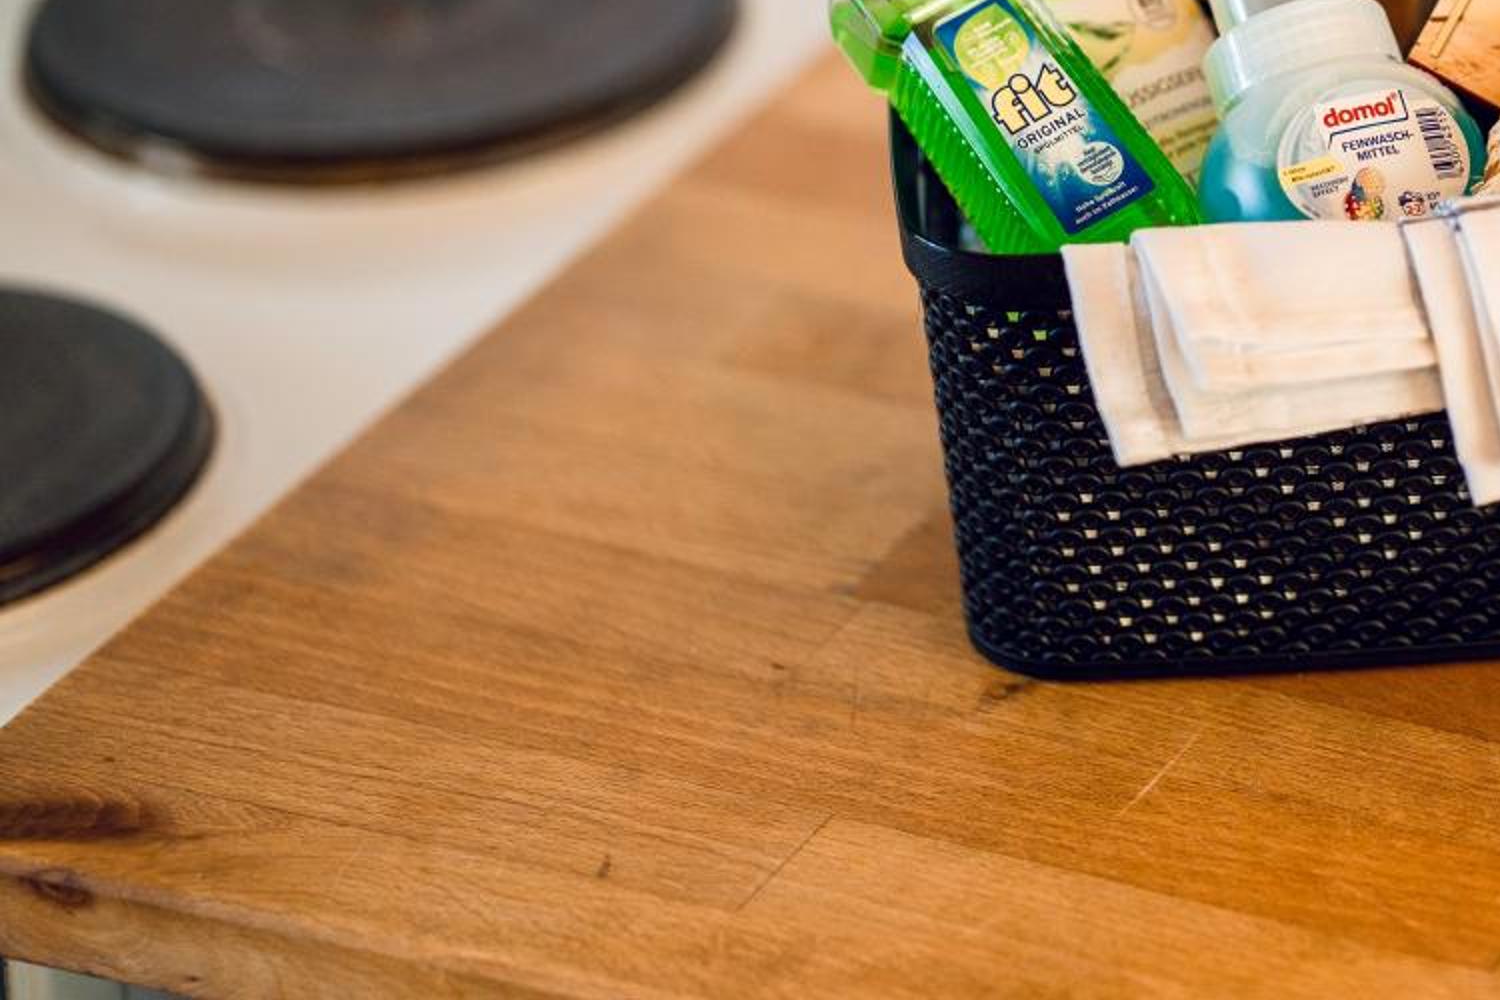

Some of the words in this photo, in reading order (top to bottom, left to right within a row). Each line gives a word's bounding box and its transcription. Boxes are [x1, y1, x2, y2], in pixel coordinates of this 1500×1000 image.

[991, 63, 1077, 136] fit
[1323, 96, 1395, 128] domol
[1017, 107, 1086, 149] ORIGINAL
[1341, 130, 1414, 153] FEINWASCH-
[1356, 144, 1401, 162] MITTEL
